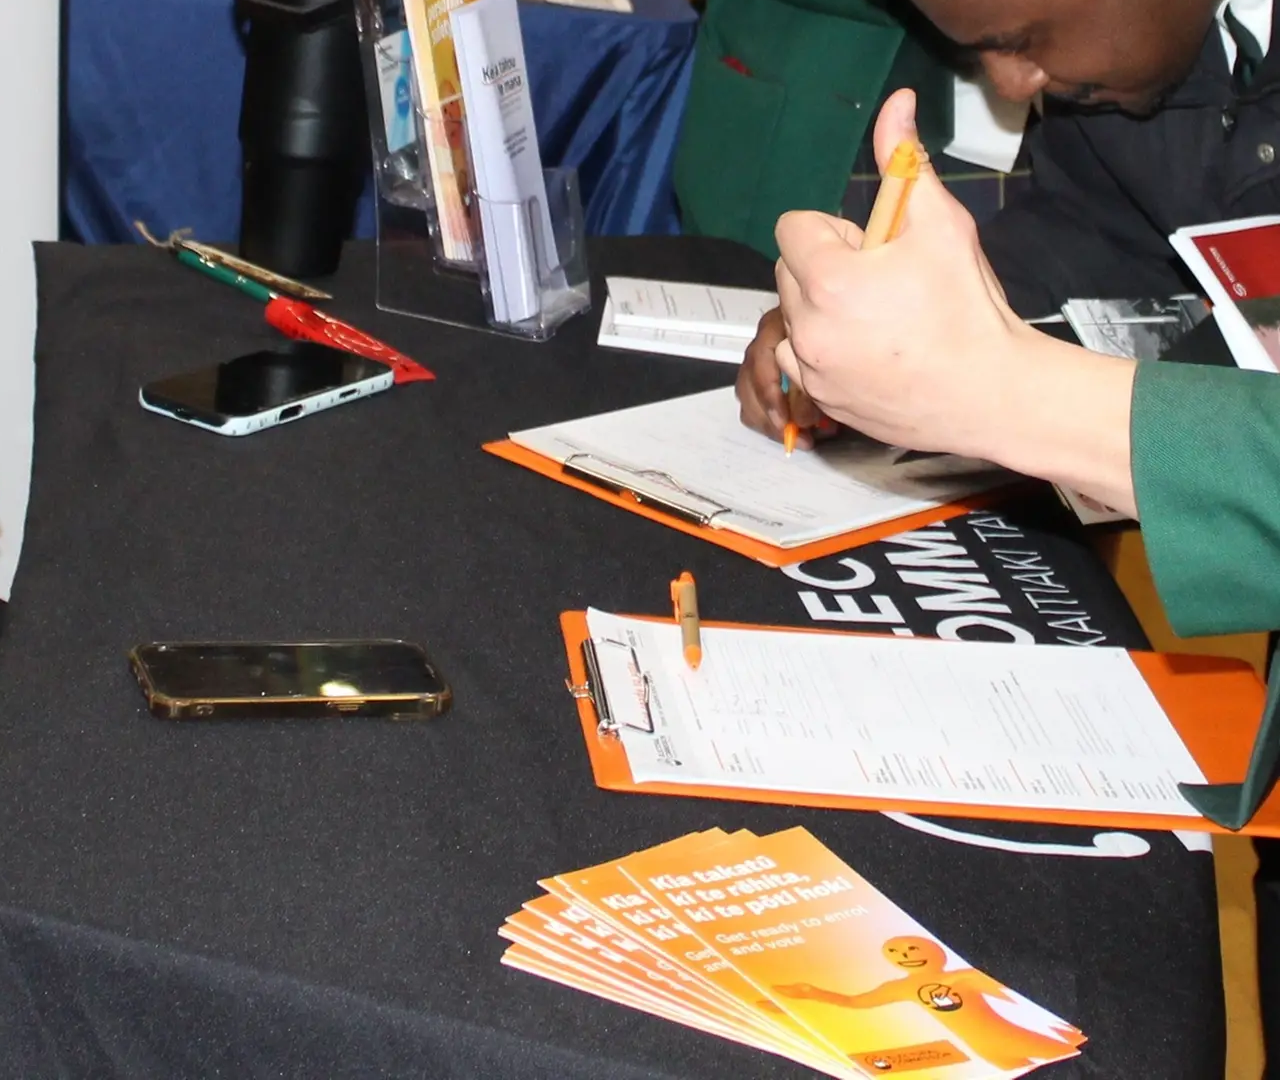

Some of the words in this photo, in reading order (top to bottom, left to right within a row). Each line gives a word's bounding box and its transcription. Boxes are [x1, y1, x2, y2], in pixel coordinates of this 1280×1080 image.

[648, 874, 695, 891] Kia
[601, 893, 648, 910] Kia
[665, 890, 698, 907] ki
[695, 888, 726, 903] te
[684, 906, 716, 923] ki
[714, 904, 745, 918] te
[795, 876, 854, 902] hoki
[622, 909, 656, 926] ki
[715, 932, 749, 945] Get
[750, 921, 800, 939] ready
[799, 917, 822, 928] to
[824, 904, 869, 924] enrol
[645, 924, 679, 941] ki
[729, 942, 765, 956] and
[764, 934, 807, 950] vote
